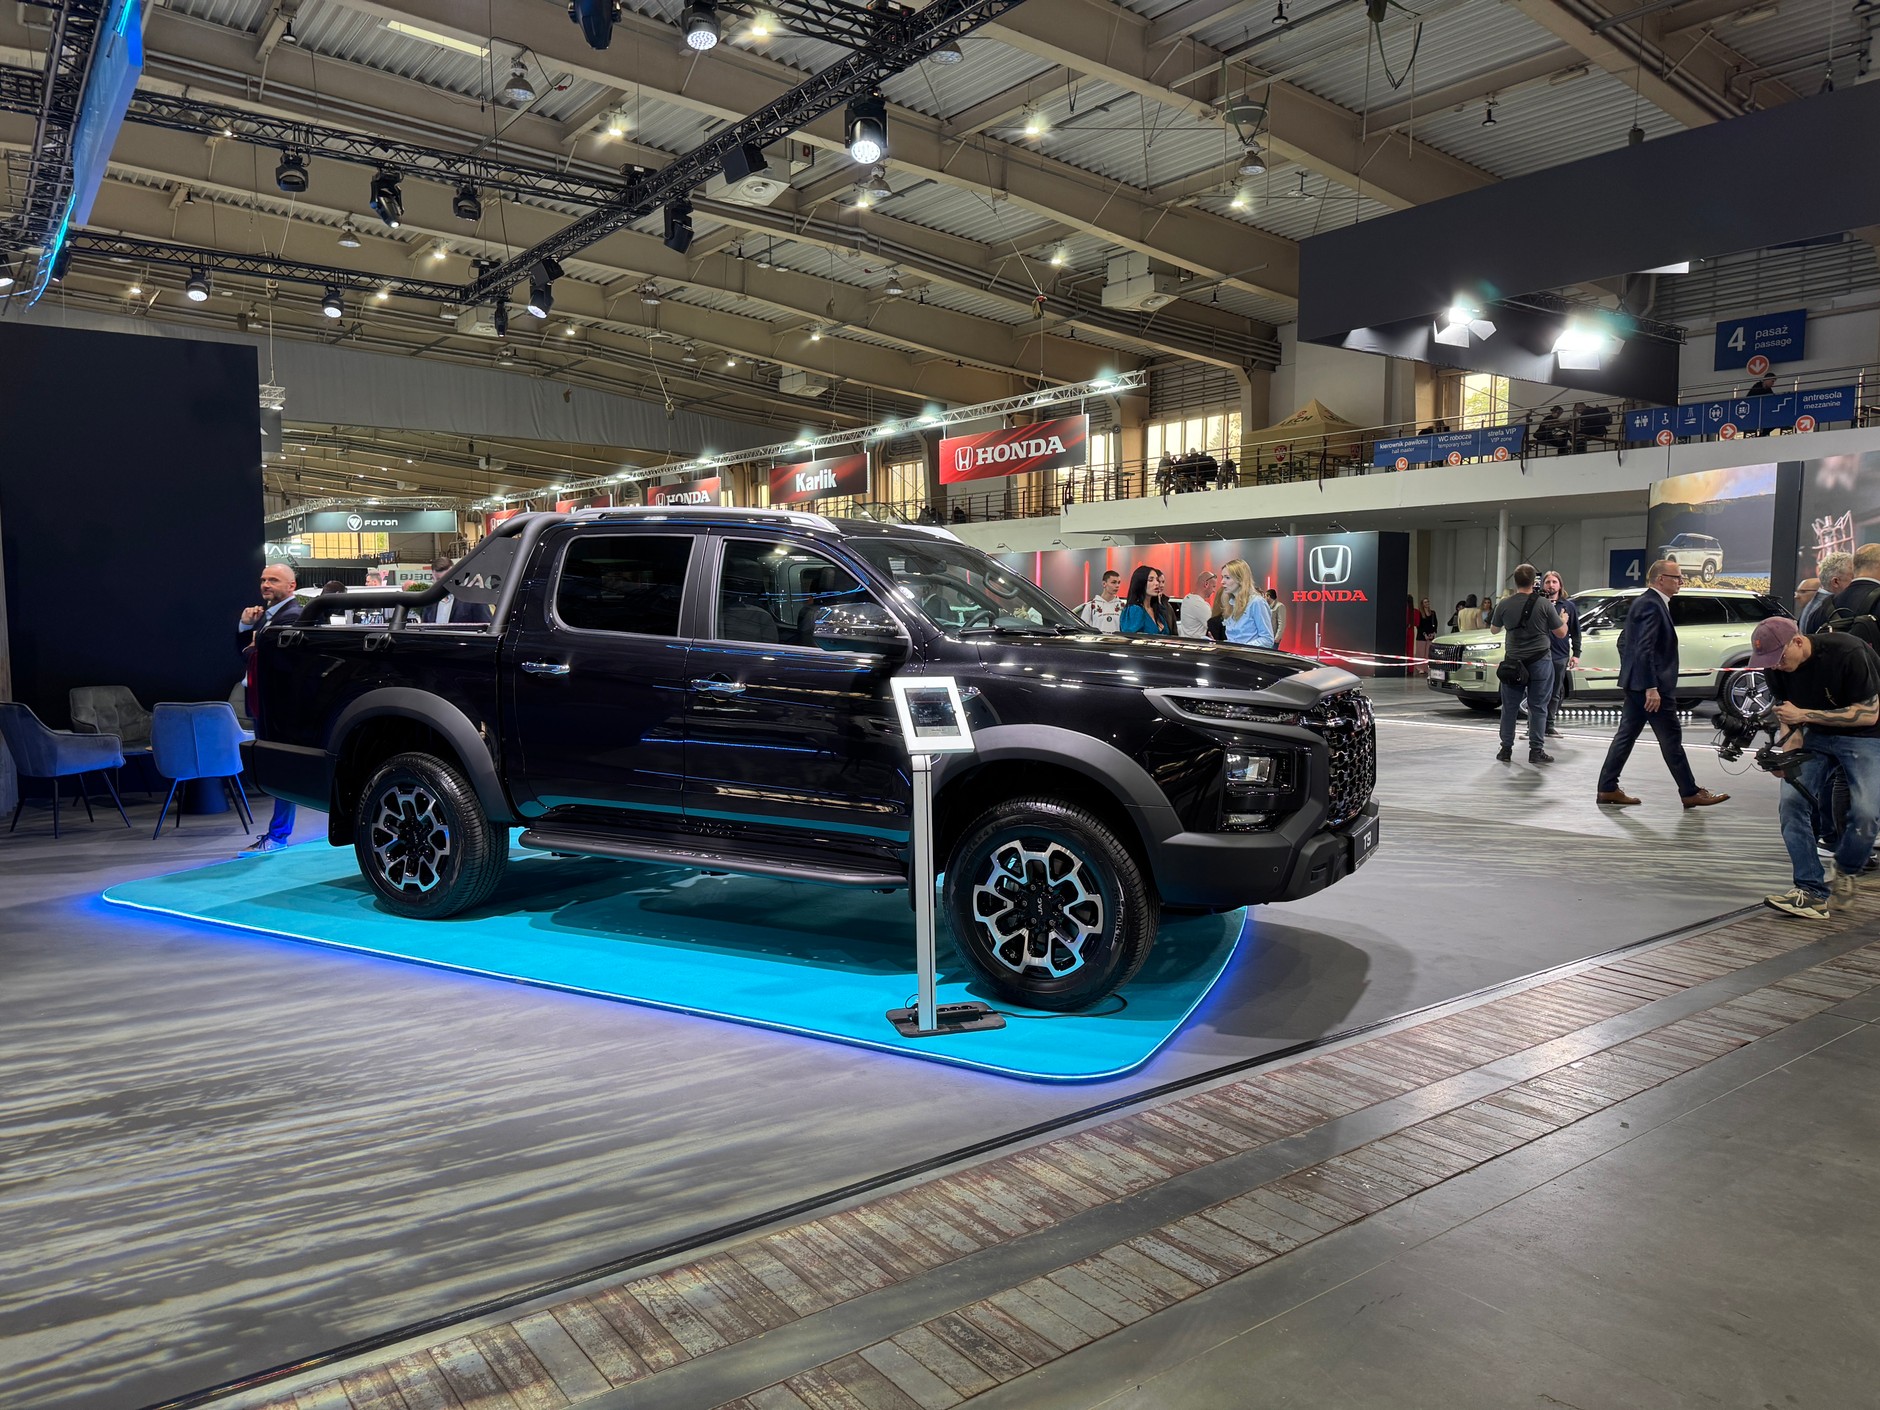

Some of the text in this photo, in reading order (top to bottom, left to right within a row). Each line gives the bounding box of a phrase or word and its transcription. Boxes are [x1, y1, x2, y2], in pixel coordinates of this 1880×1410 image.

[1727, 326, 1746, 352] 4
[1755, 325, 1788, 340] pasaż
[1754, 337, 1792, 351] passage
[1802, 391, 1842, 402] antresola
[1803, 401, 1841, 410] mezzanine
[1379, 438, 1428, 450] kierownik pawilonu
[1450, 433, 1472, 441] robocze
[975, 437, 1066, 466] HONDA
[1437, 442, 1460, 450] temporary
[795, 468, 837, 493] Karlik
[666, 490, 711, 507] HONDA
[264, 545, 302, 556] AIC
[1625, 559, 1641, 581] 4
[454, 572, 501, 590] JAC
[1291, 589, 1369, 603] HONDA
[1363, 831, 1372, 850] T9
